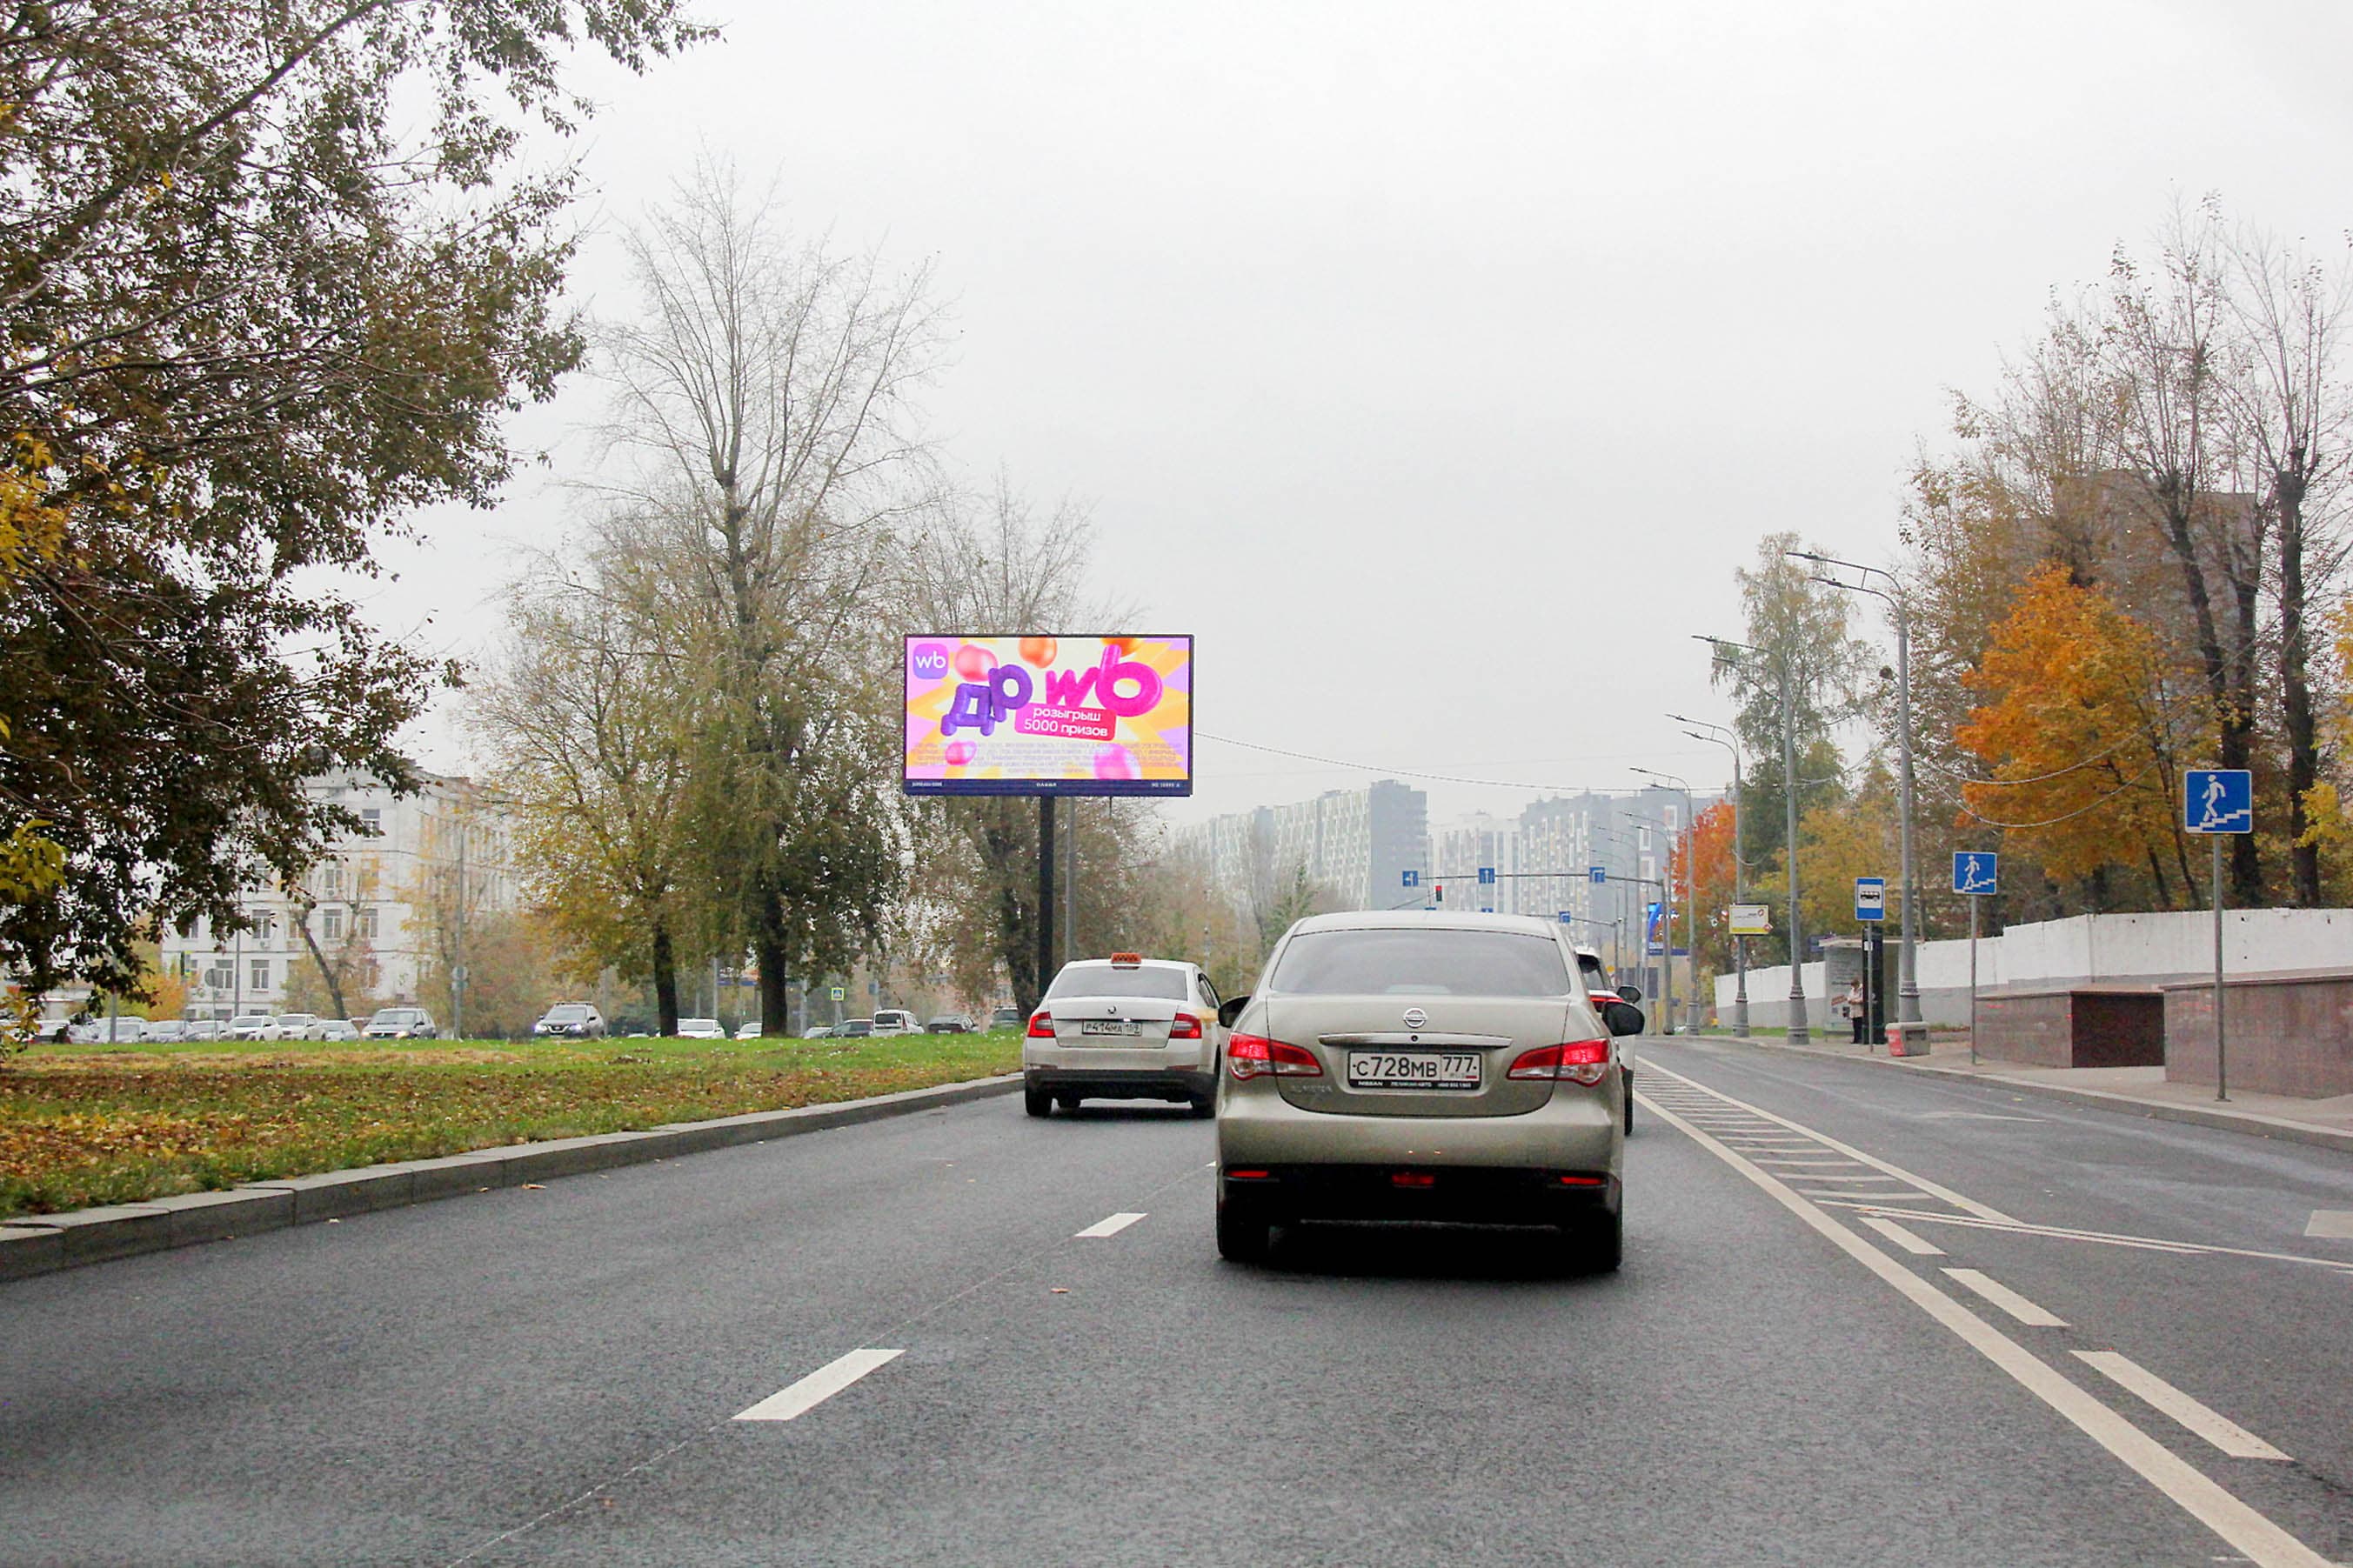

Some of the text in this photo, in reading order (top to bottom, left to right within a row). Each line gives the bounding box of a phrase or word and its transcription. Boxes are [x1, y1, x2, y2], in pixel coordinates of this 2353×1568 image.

[915, 651, 946, 669] wb
[1033, 707, 1101, 722] розыгрыш
[1024, 718, 1108, 737] 5000 призов
[1442, 1057, 1474, 1072] 777
